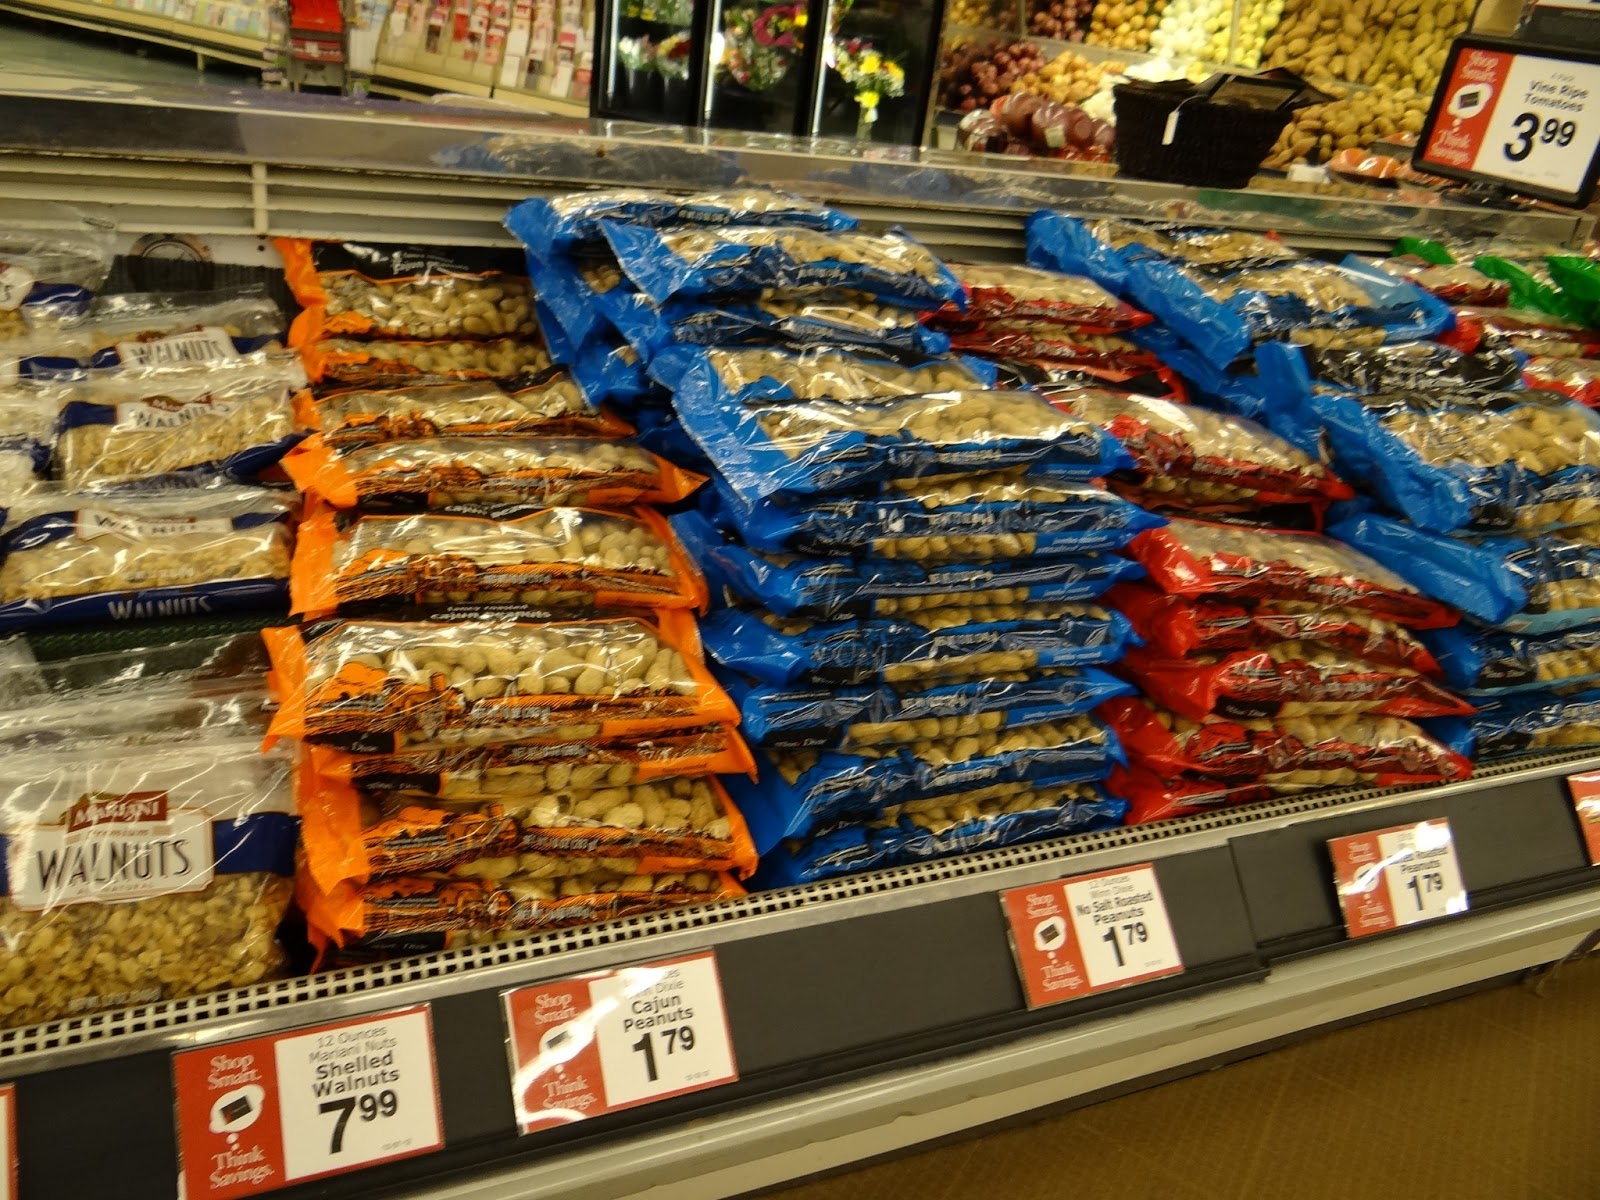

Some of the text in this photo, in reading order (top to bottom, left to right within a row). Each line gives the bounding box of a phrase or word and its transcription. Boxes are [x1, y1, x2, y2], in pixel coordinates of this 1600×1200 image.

[1529, 80, 1590, 100] Vine Ripe
[1524, 92, 1585, 112] Tomatoes
[37, 839, 191, 891] WALNUTS
[1400, 860, 1441, 875] Peanuts
[1075, 890, 1155, 917] No Salt Roasted
[1093, 906, 1145, 926] Peanuts
[655, 978, 685, 994] Dixie
[534, 993, 573, 1009] Shop
[631, 993, 682, 1015] Cajun
[623, 1006, 694, 1033] Peanuts
[316, 1025, 388, 1049] 12 Ounces
[308, 1036, 398, 1064] Mariani Nuts
[210, 1053, 255, 1073] Shop
[315, 1050, 395, 1081] Shelled
[311, 1068, 400, 1099] Walnuts
[543, 1076, 590, 1098] Think
[210, 1145, 266, 1171] Think
